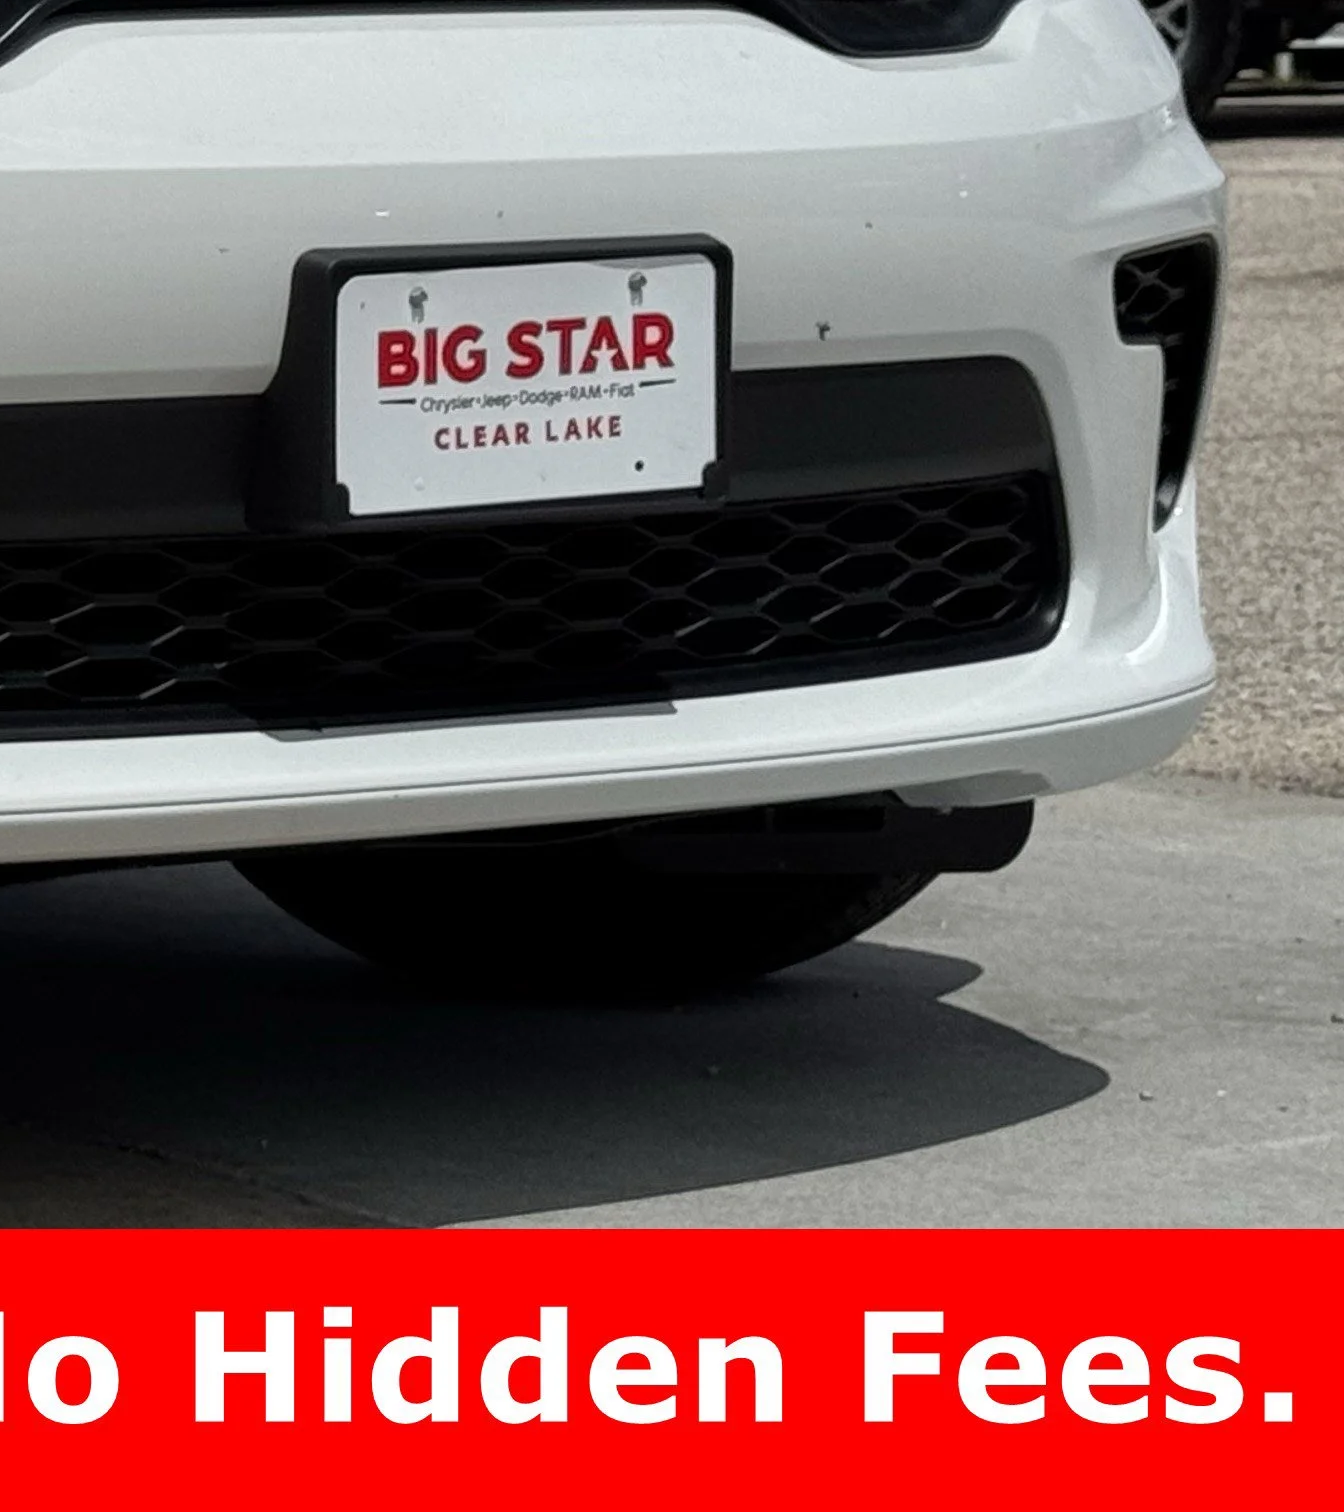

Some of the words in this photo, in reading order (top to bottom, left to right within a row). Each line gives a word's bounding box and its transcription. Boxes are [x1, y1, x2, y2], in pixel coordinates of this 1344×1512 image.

[377, 325, 487, 387] BIG
[506, 313, 675, 379] STAR
[434, 422, 532, 451] CLEAR
[545, 415, 623, 442] LAKE
